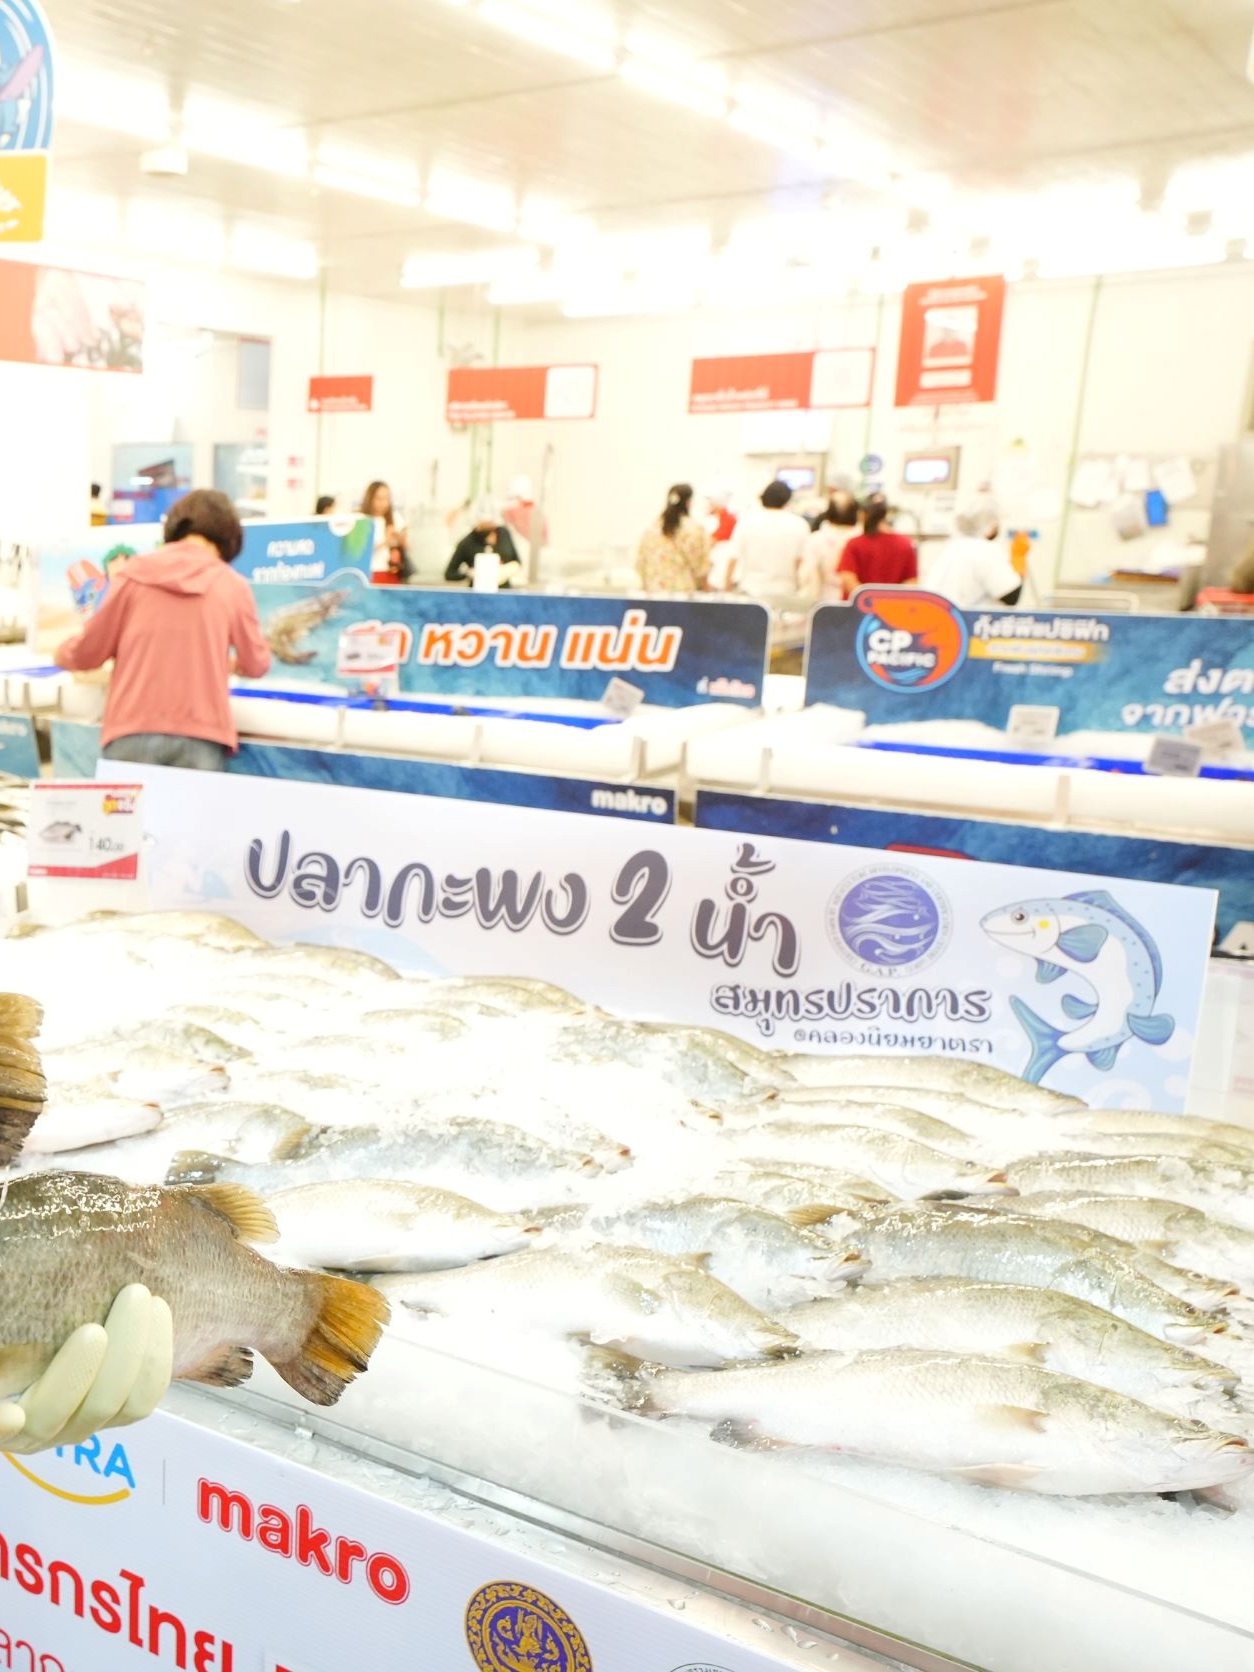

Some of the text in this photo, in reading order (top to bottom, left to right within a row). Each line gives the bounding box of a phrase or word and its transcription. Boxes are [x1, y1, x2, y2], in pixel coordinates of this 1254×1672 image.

[420, 625, 555, 666] หวาน
[562, 611, 681, 670] แน่น
[868, 628, 913, 652] CP
[591, 788, 668, 816] makro
[245, 829, 589, 933] ปลากะพง
[608, 848, 673, 946] 2
[691, 842, 801, 976] น้ำ
[713, 981, 992, 1036] สมุทรปราการ
[55, 1434, 135, 1488] RA
[197, 1476, 411, 1605] makro
